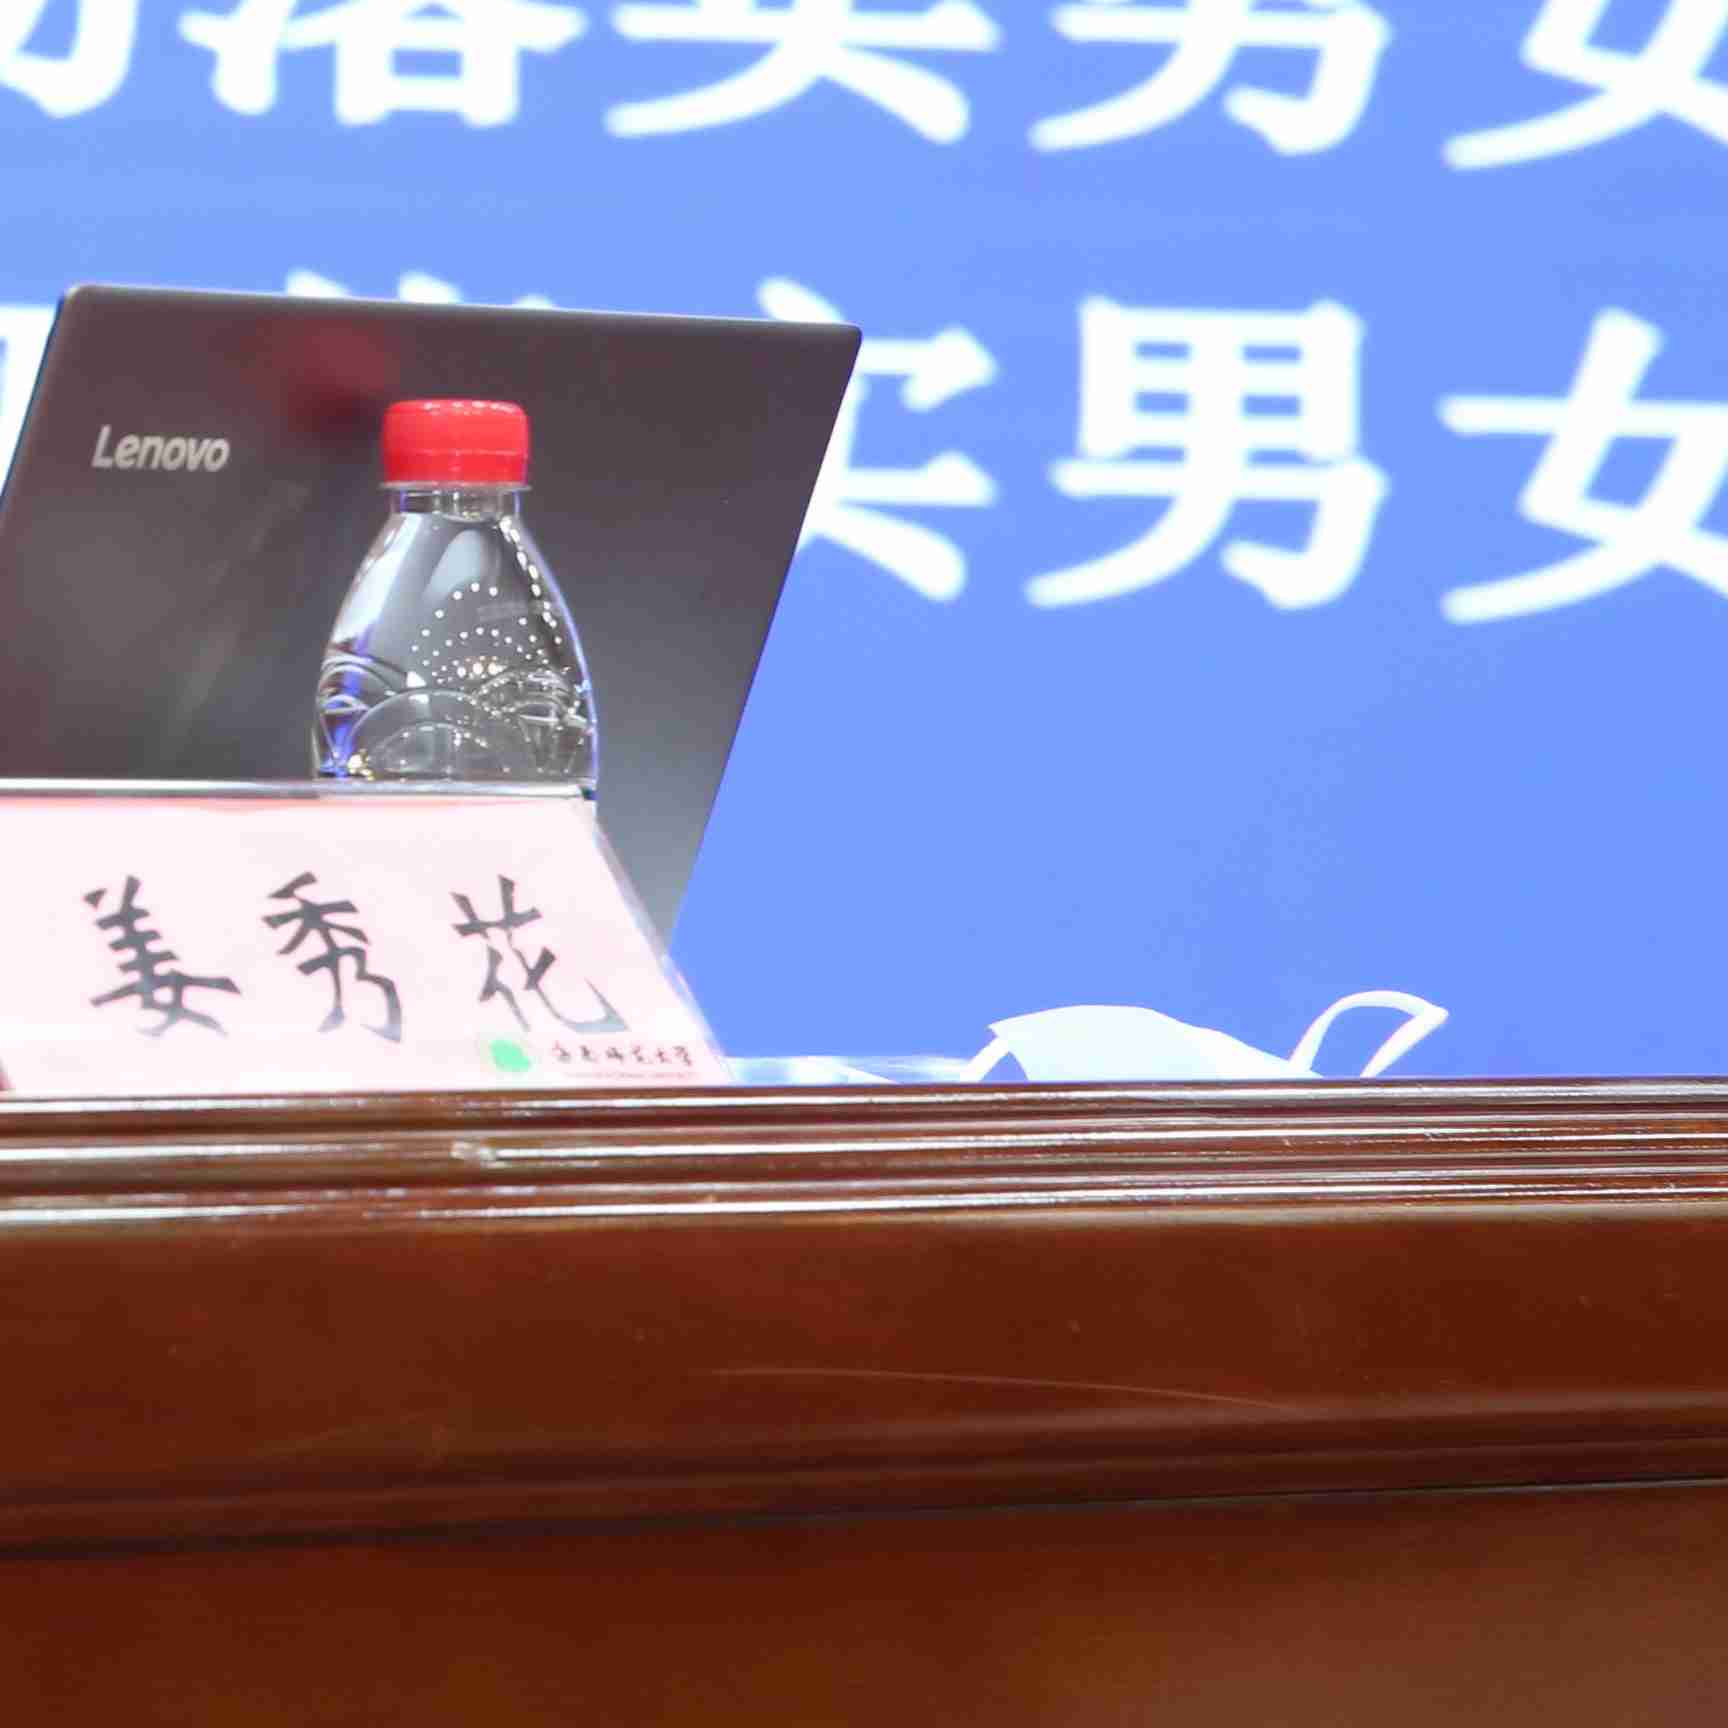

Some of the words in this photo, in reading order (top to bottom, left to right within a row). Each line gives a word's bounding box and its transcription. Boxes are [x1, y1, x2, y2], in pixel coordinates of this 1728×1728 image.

[91, 423, 231, 472] Lenovo
[81, 870, 631, 1045] 姜秀花
